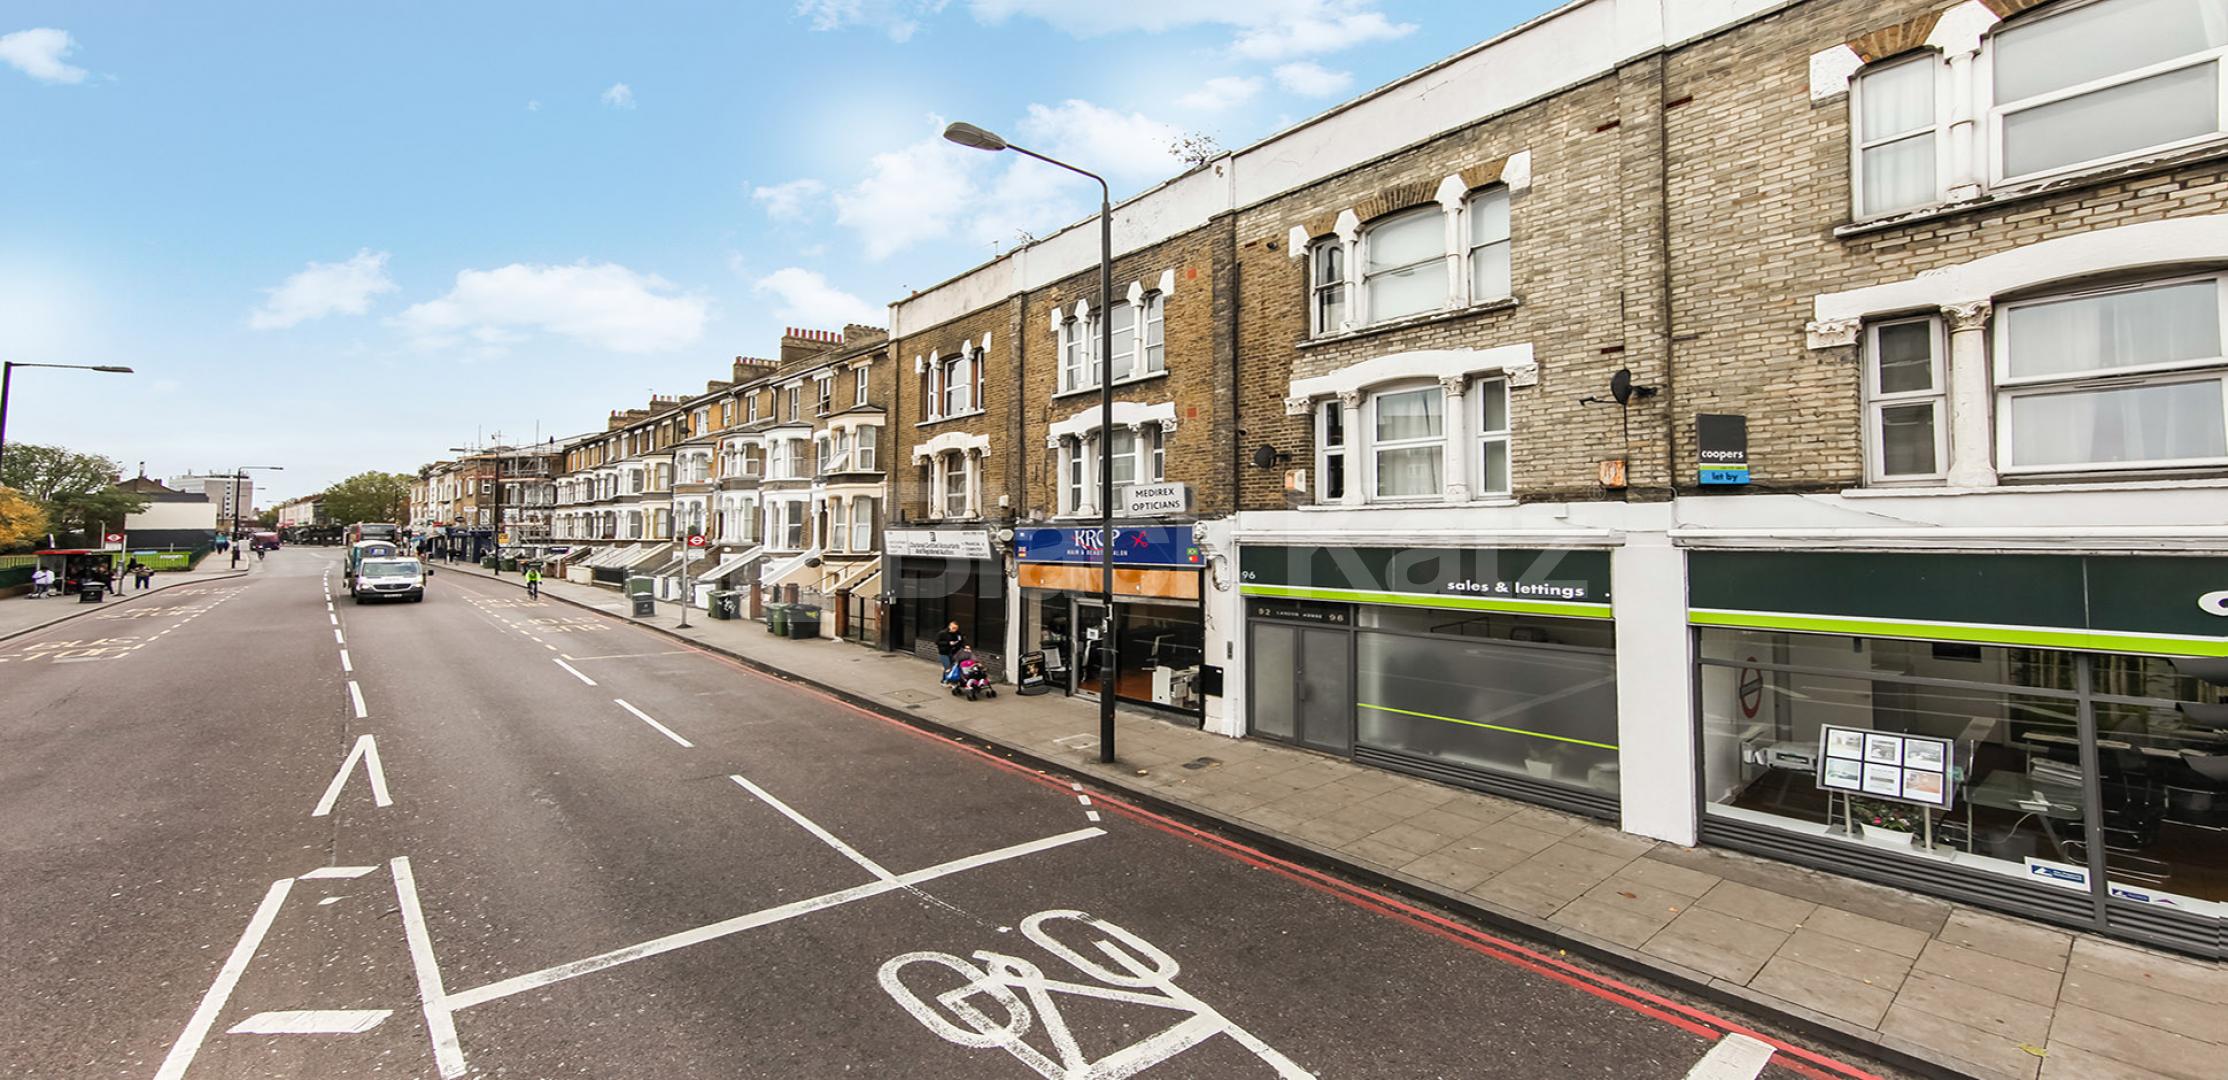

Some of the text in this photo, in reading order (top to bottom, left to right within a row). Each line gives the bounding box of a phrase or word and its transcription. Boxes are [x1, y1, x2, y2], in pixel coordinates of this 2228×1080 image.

[1701, 450, 1744, 461] coopers
[1711, 471, 1738, 482] let by
[1135, 487, 1175, 498] MEDIREX
[1131, 500, 1181, 511] OPTICIANS
[1241, 570, 1256, 580] 96
[1447, 579, 1584, 599] sales & lettings
[1329, 614, 1344, 622] 96
